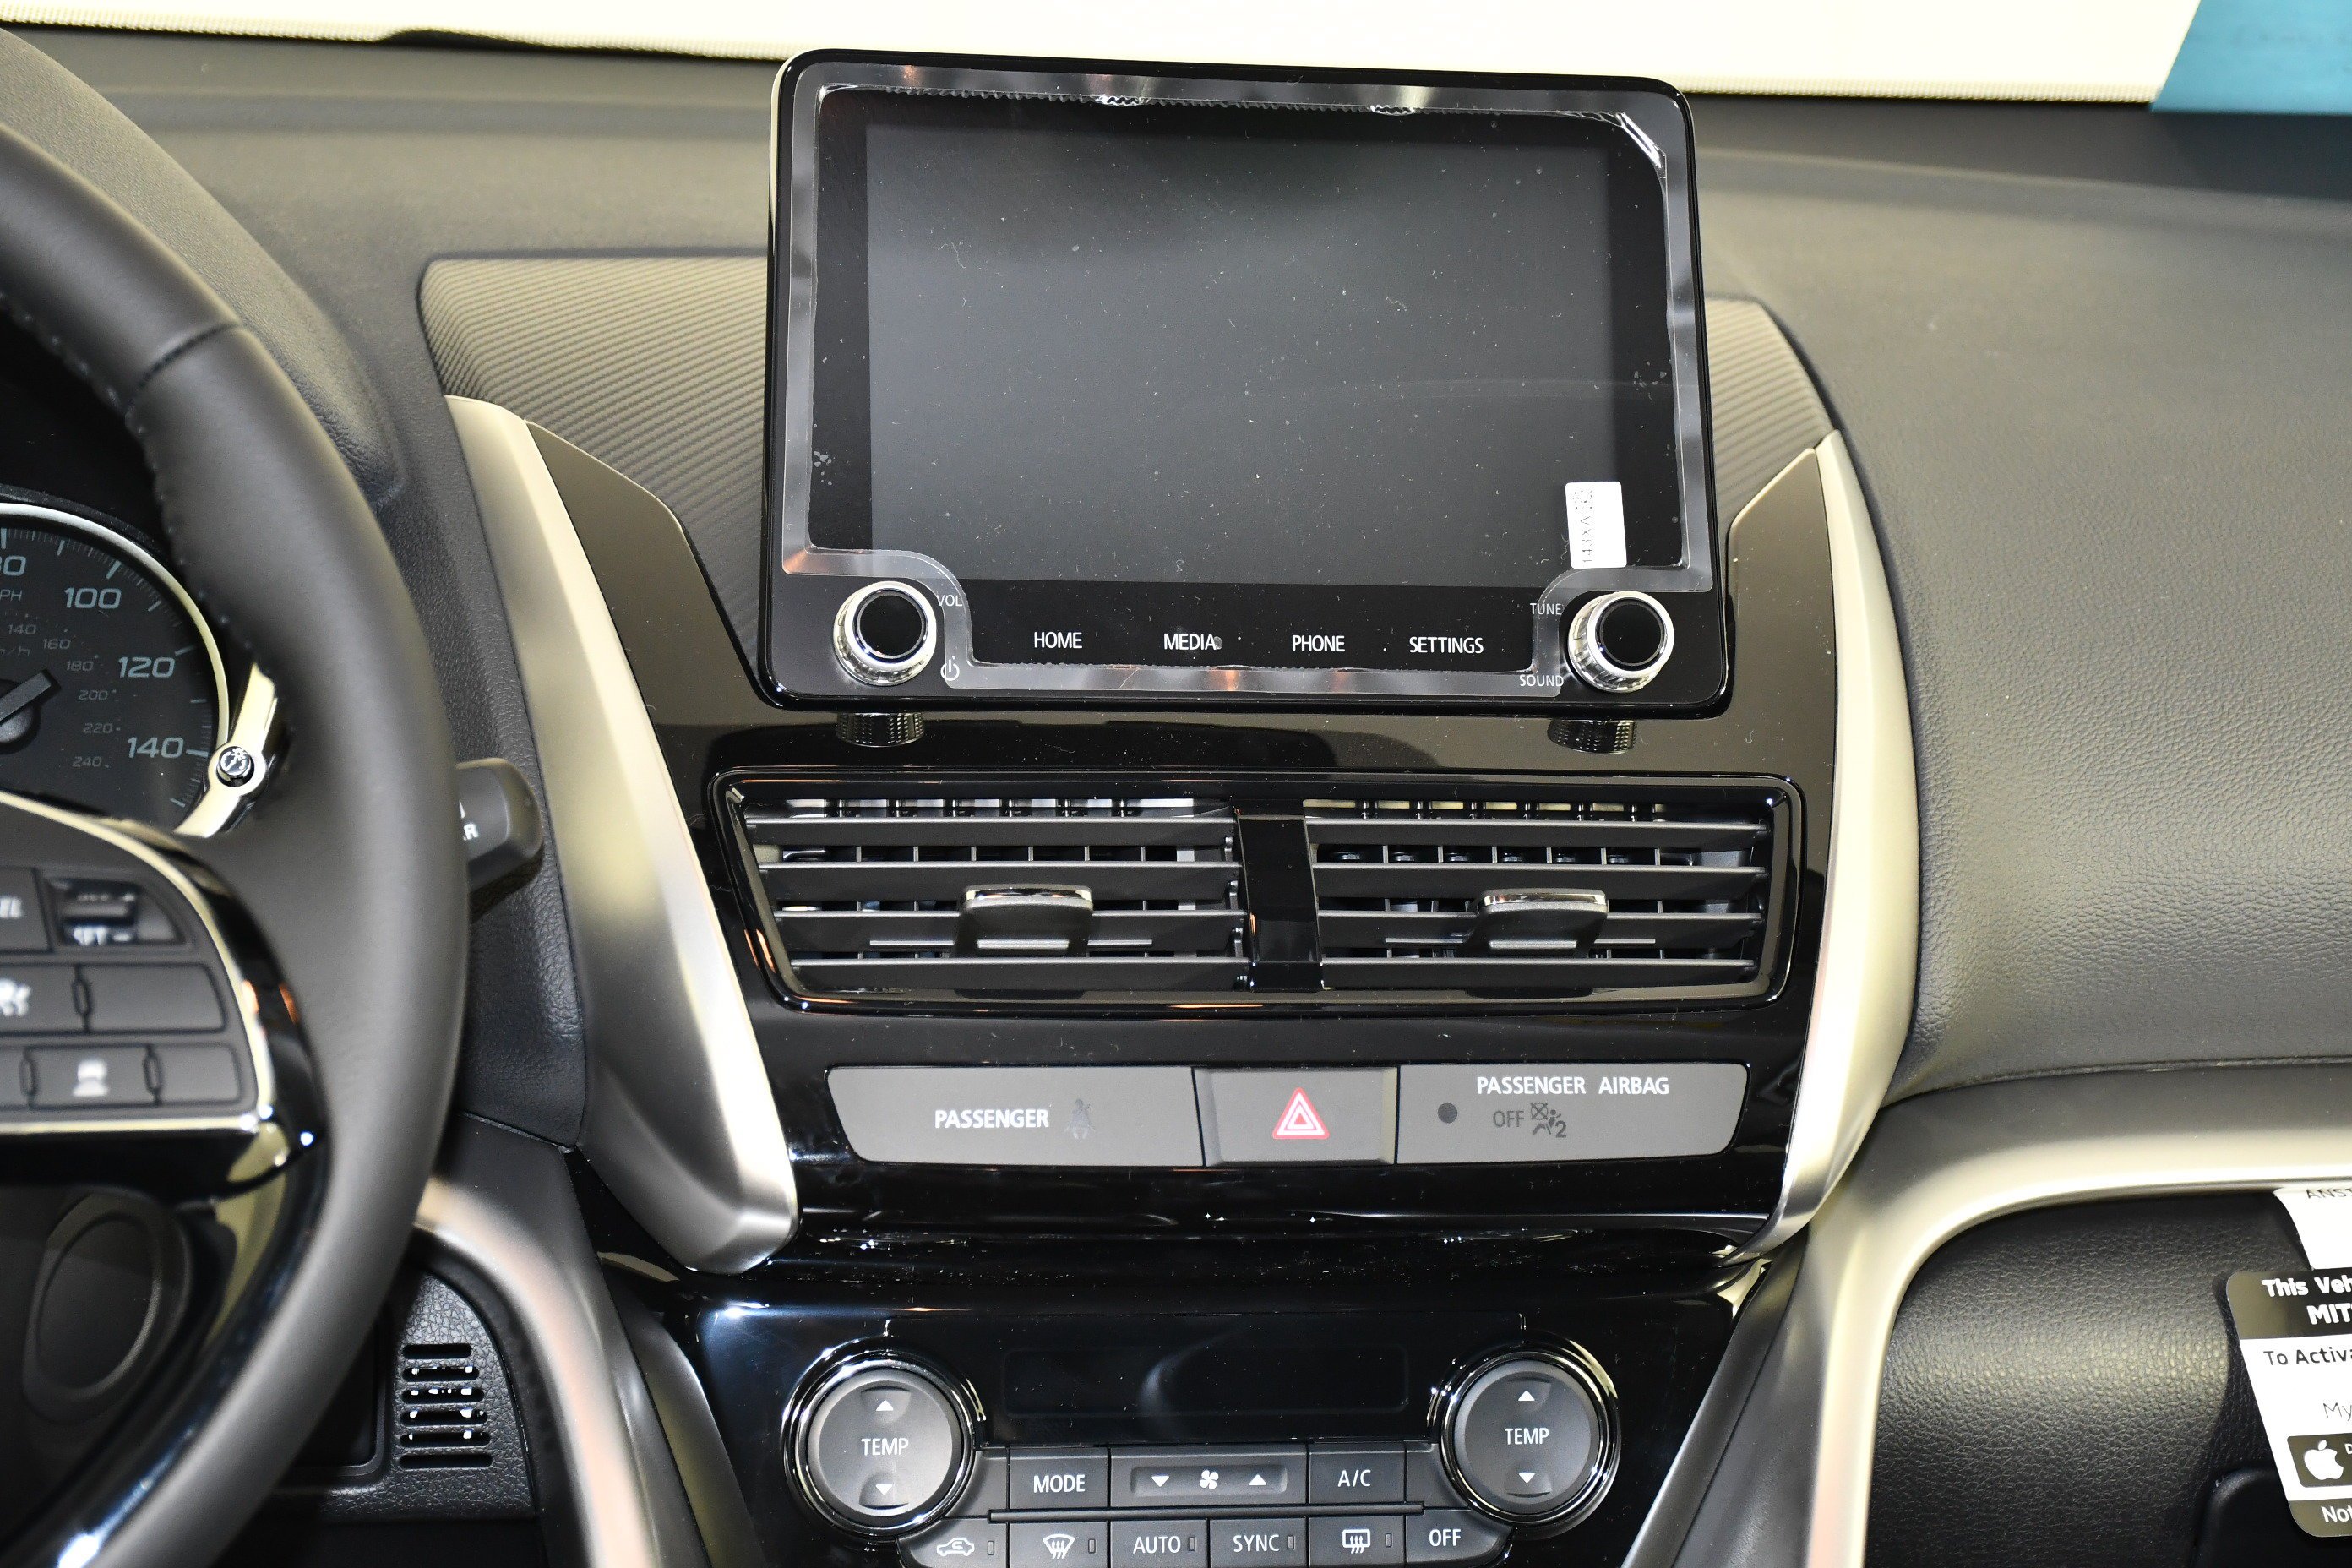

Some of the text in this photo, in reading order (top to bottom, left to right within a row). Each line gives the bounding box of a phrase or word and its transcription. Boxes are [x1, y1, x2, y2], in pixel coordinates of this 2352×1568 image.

[0, 556, 26, 576] 0
[64, 587, 122, 609] 100
[935, 594, 963, 607] VOL
[1530, 602, 1562, 615] TUNE
[8, 624, 36, 634] 140
[43, 638, 71, 650] 160
[1033, 631, 1083, 649] HOME
[1163, 633, 1216, 651] MEDIA
[1292, 634, 1346, 652] PHONE
[1409, 636, 1484, 654] SETTINGS
[66, 661, 94, 672] 180
[118, 656, 176, 678] 120
[1519, 674, 1565, 687] SOUND
[79, 689, 108, 700] 200
[83, 722, 113, 733] 220
[127, 737, 184, 759] 140
[72, 756, 101, 767] 240
[1478, 1076, 1670, 1095] PASSENGER AIRBAG
[934, 1108, 1049, 1129] PASSENGER
[1492, 1110, 1525, 1128] OFF
[2262, 1274, 2352, 1297] This Veh
[2306, 1303, 2352, 1325] MIT
[2263, 1347, 2352, 1366] To Activ
[2323, 1402, 2352, 1421] My
[1504, 1427, 1549, 1446] TEMP
[861, 1438, 909, 1456] TEMP
[1033, 1474, 1086, 1494] MODE
[1337, 1469, 1371, 1488] A/C
[1133, 1535, 1181, 1554] AUTO
[1233, 1533, 1280, 1553] SYNC
[1429, 1528, 1462, 1547] OFF
